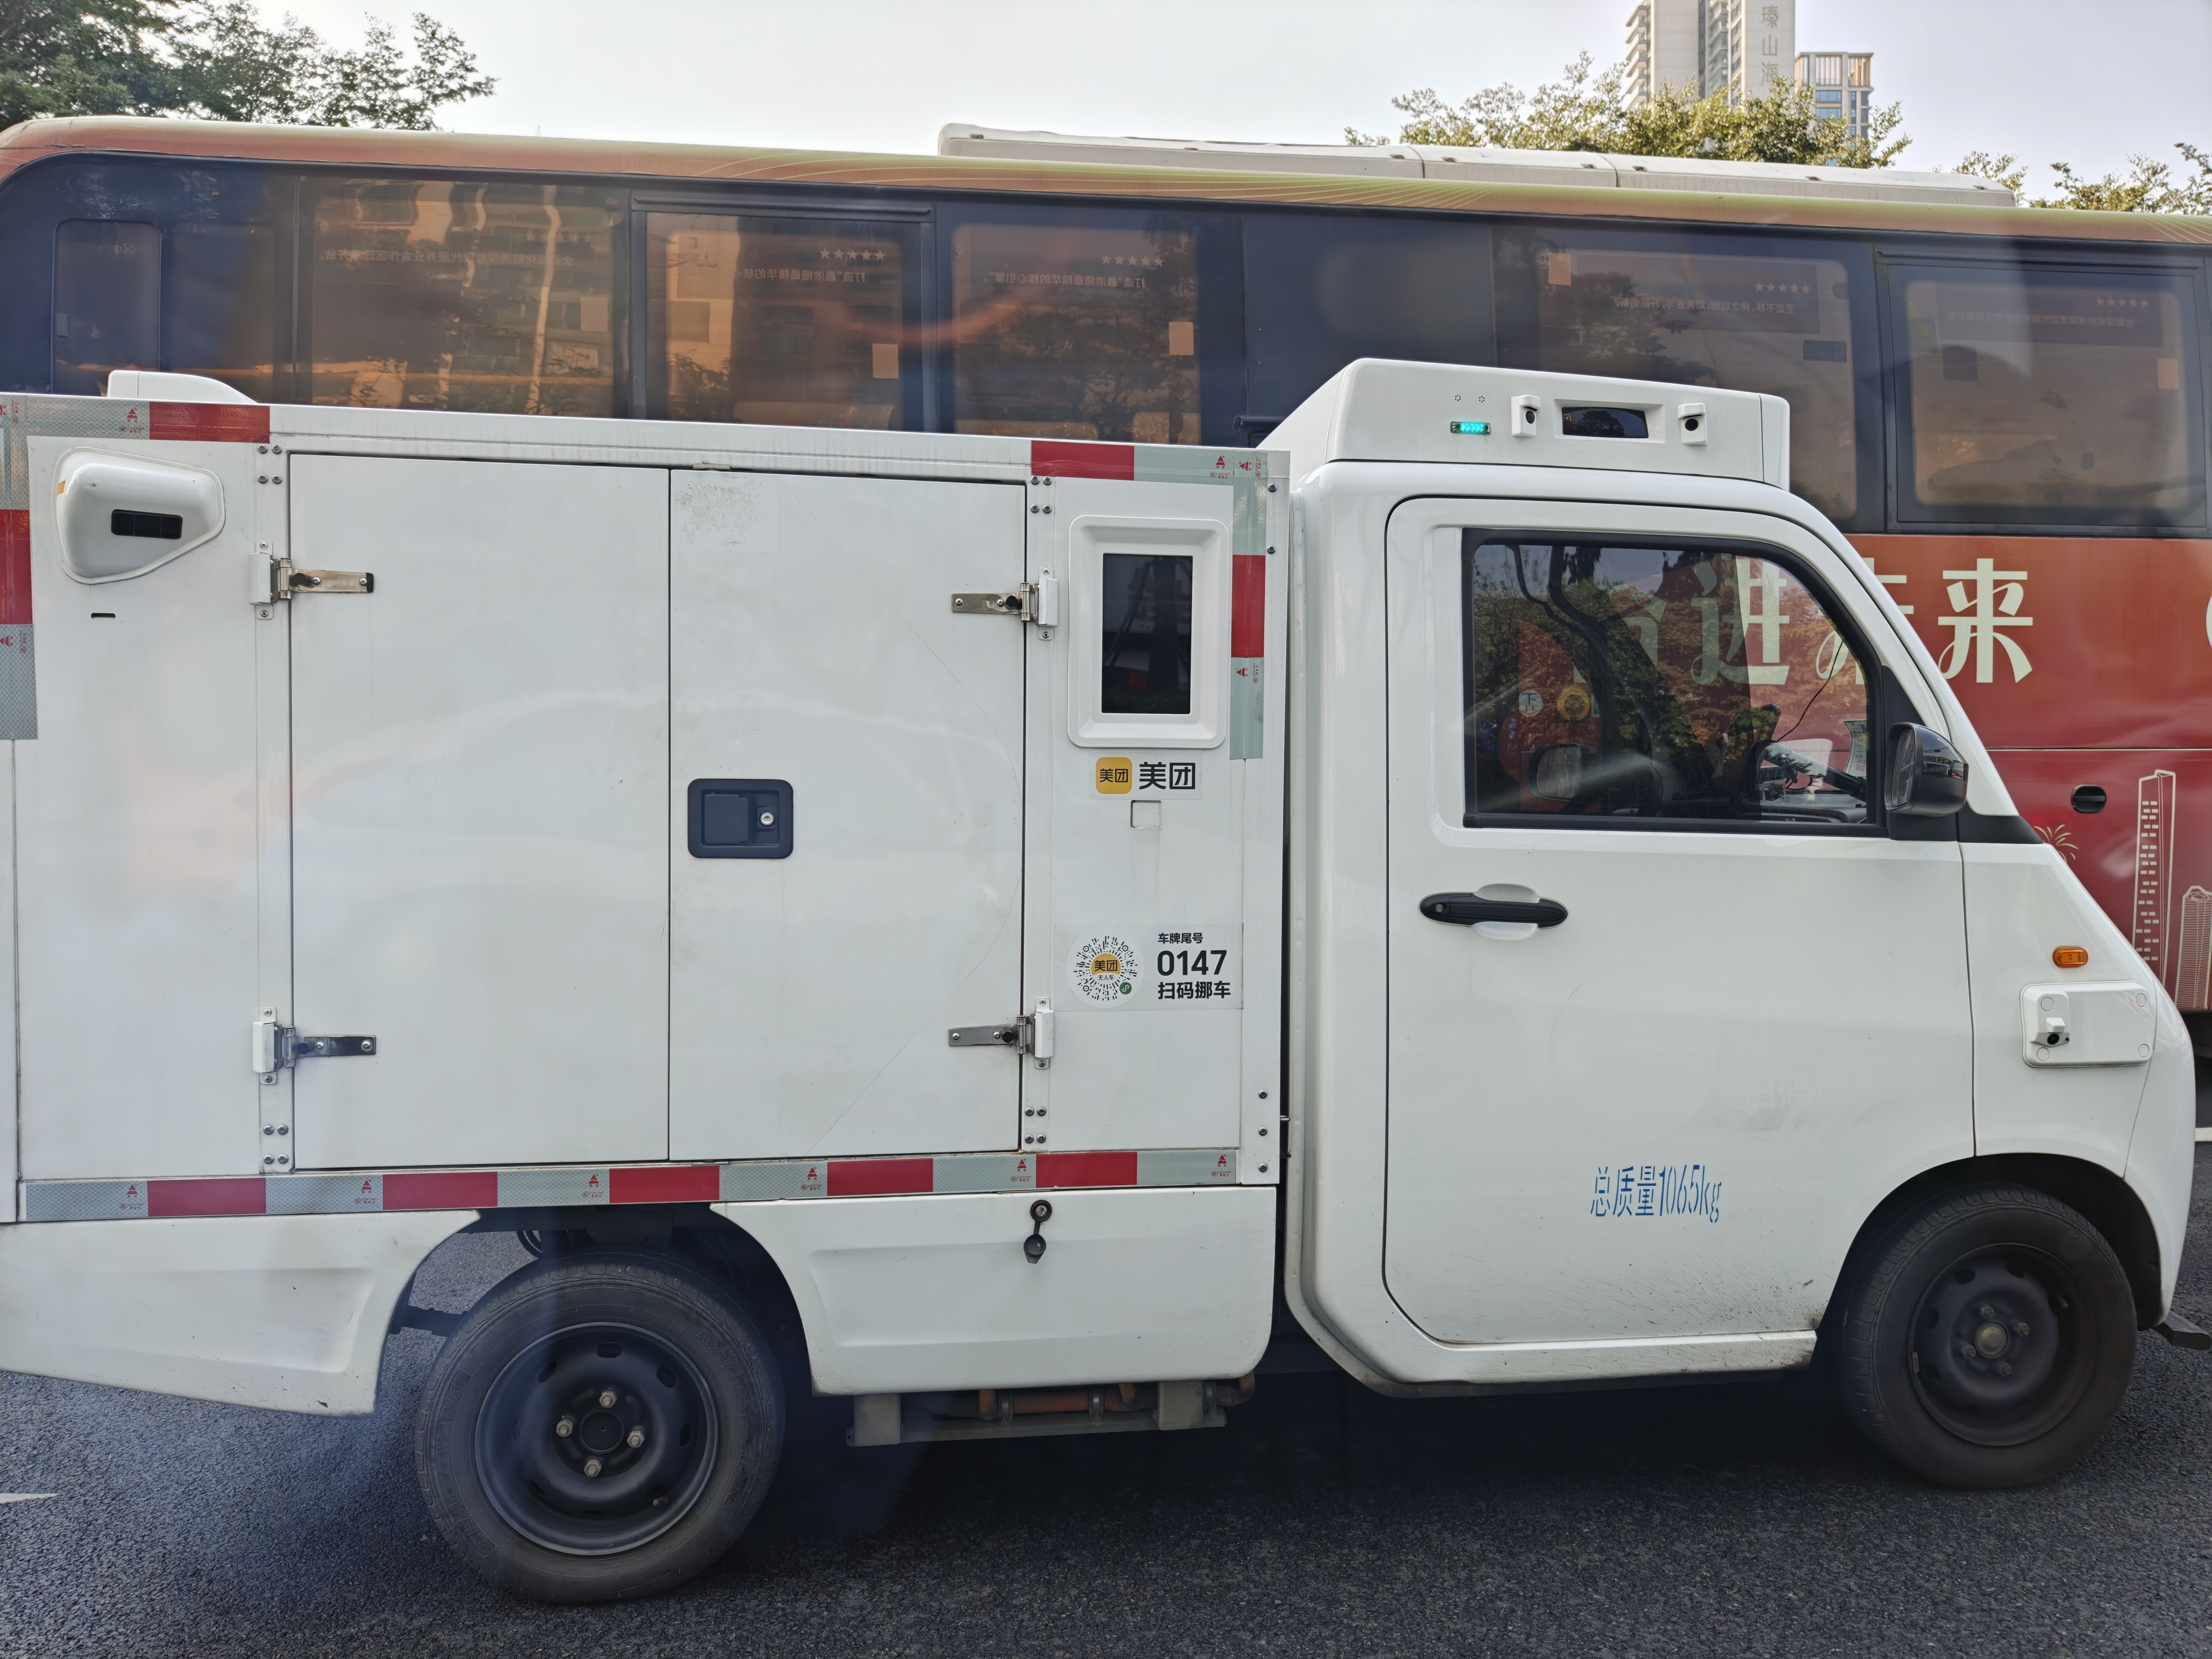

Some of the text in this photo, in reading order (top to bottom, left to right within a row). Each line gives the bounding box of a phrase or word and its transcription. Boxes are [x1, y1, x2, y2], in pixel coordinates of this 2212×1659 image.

[1100, 762, 1195, 790] 美团 美团
[1158, 933, 1203, 944] 车牌尾号
[1094, 960, 1117, 972] 美团
[1157, 950, 1227, 976] 0147
[1158, 981, 1231, 999] 扫码挪车
[1590, 1165, 1721, 1223] 总质量1065kg
